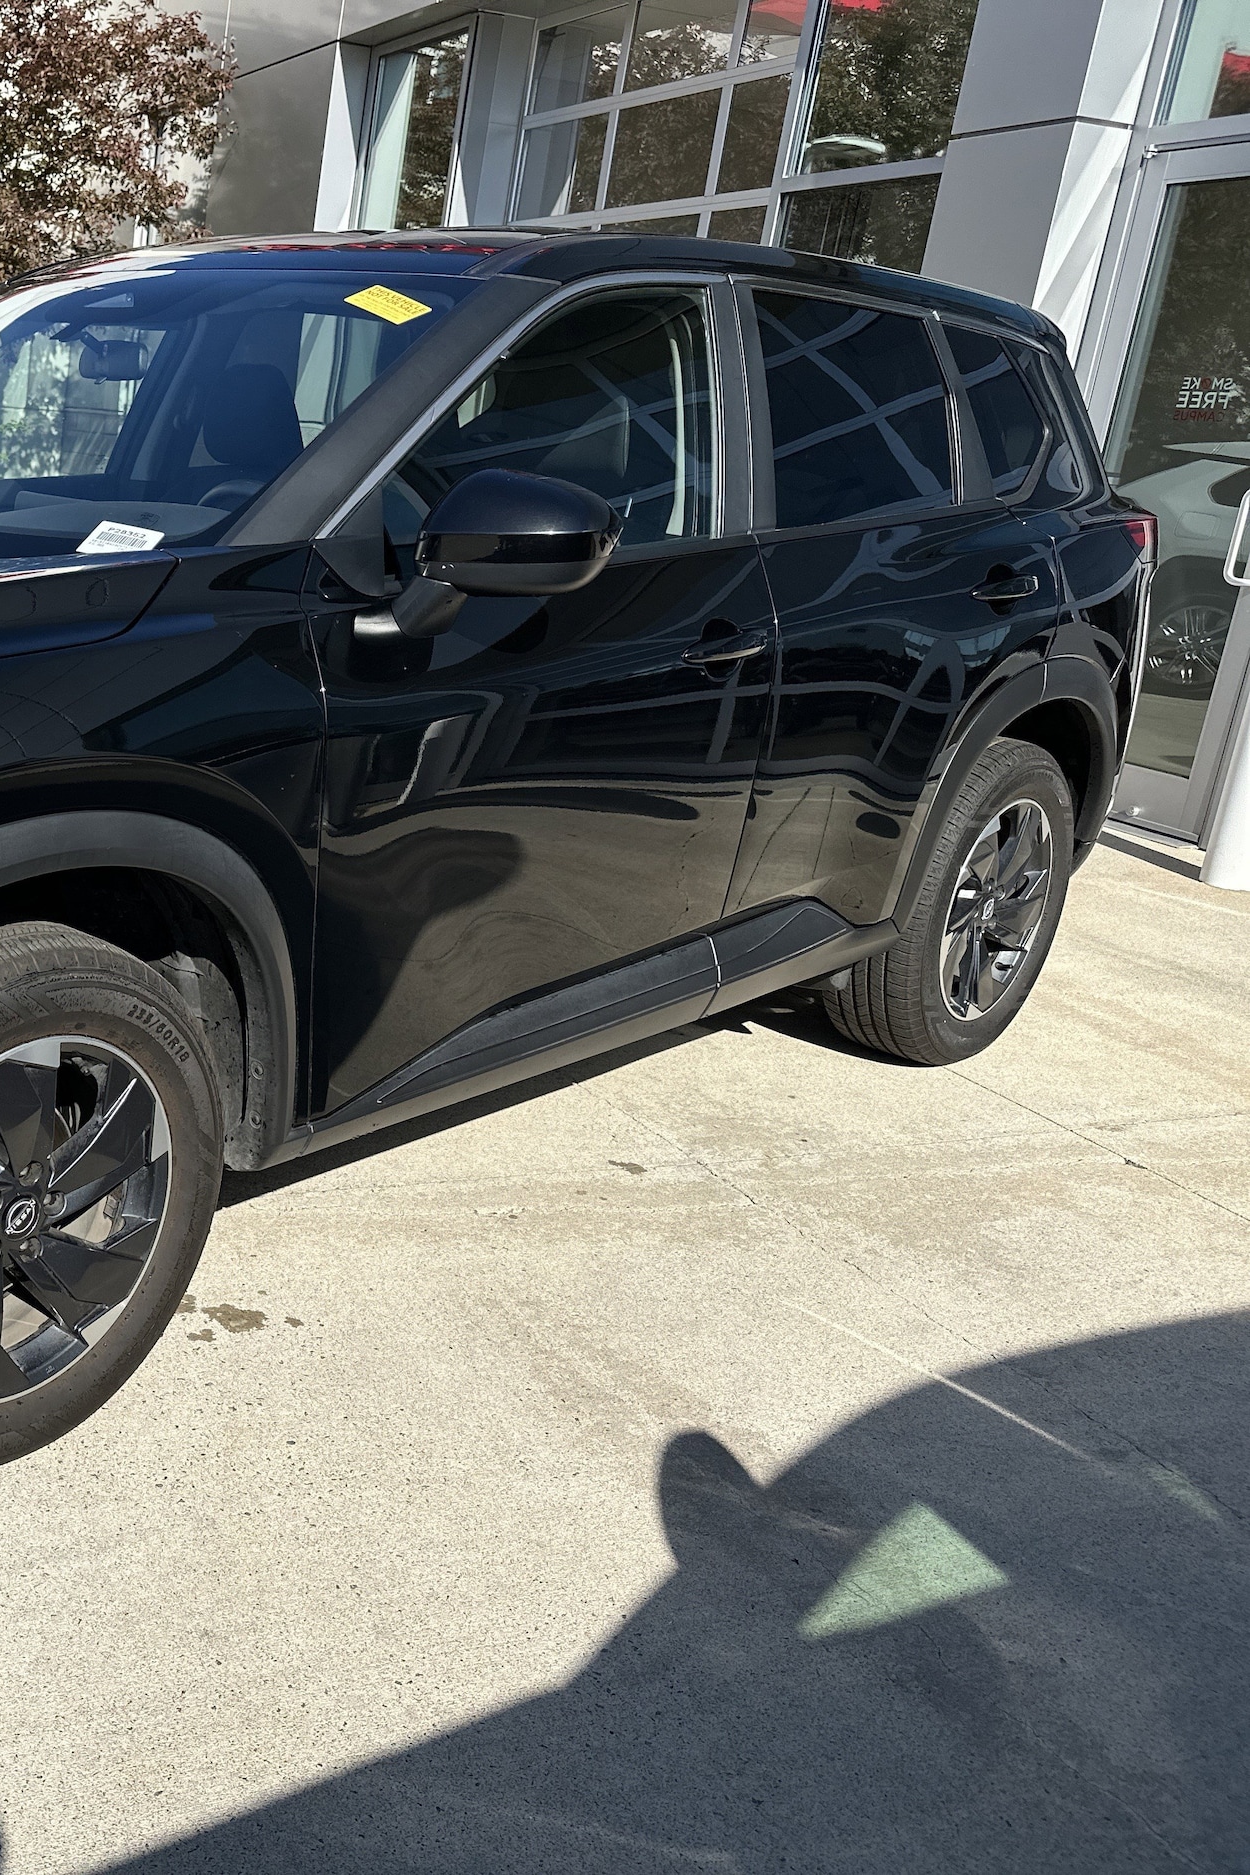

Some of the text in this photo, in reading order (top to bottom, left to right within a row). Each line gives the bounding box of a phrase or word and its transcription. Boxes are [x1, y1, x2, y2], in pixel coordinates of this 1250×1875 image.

[366, 290, 419, 315] NOT FOR SALE
[373, 286, 391, 297] THIS
[391, 294, 429, 313] VEHICLE
